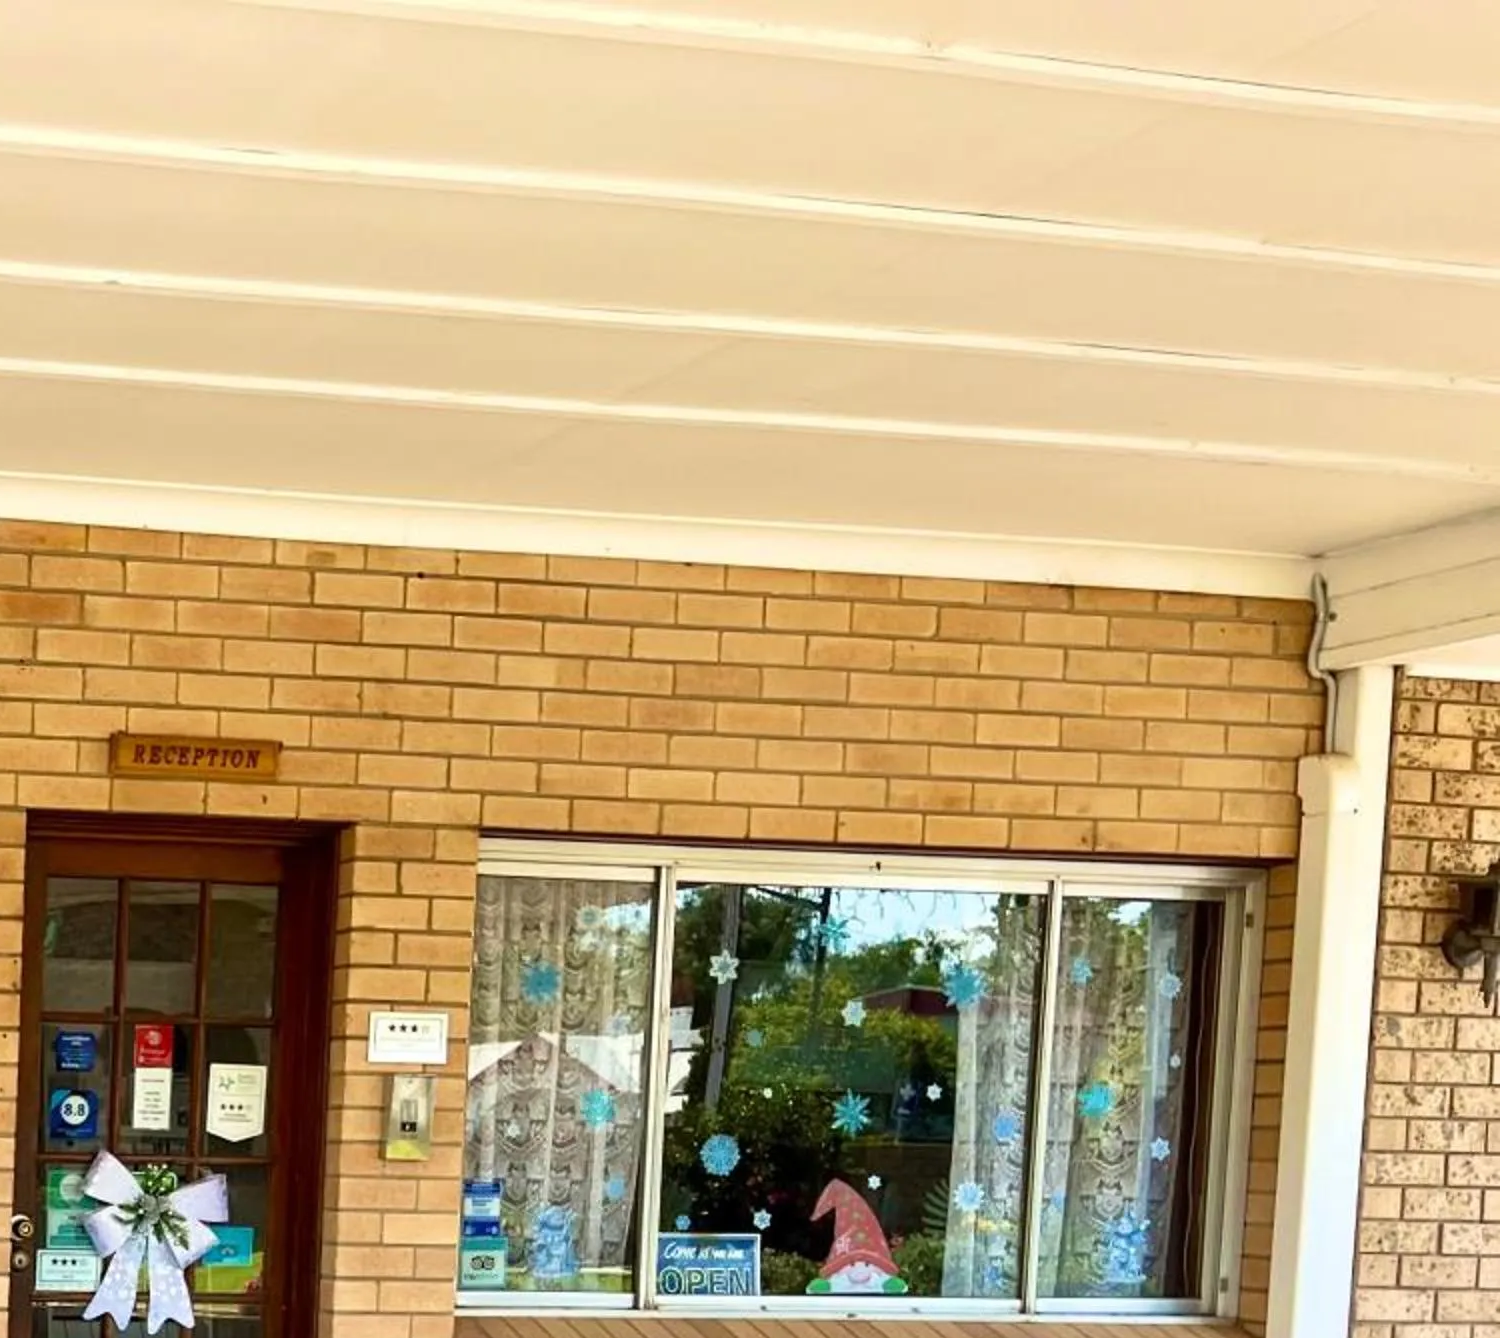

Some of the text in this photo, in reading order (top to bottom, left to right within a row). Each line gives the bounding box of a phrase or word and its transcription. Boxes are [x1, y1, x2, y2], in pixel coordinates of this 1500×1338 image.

[132, 744, 260, 769] RECEPTION
[63, 1103, 86, 1117] 8.8
[660, 1266, 752, 1296] OPEN
